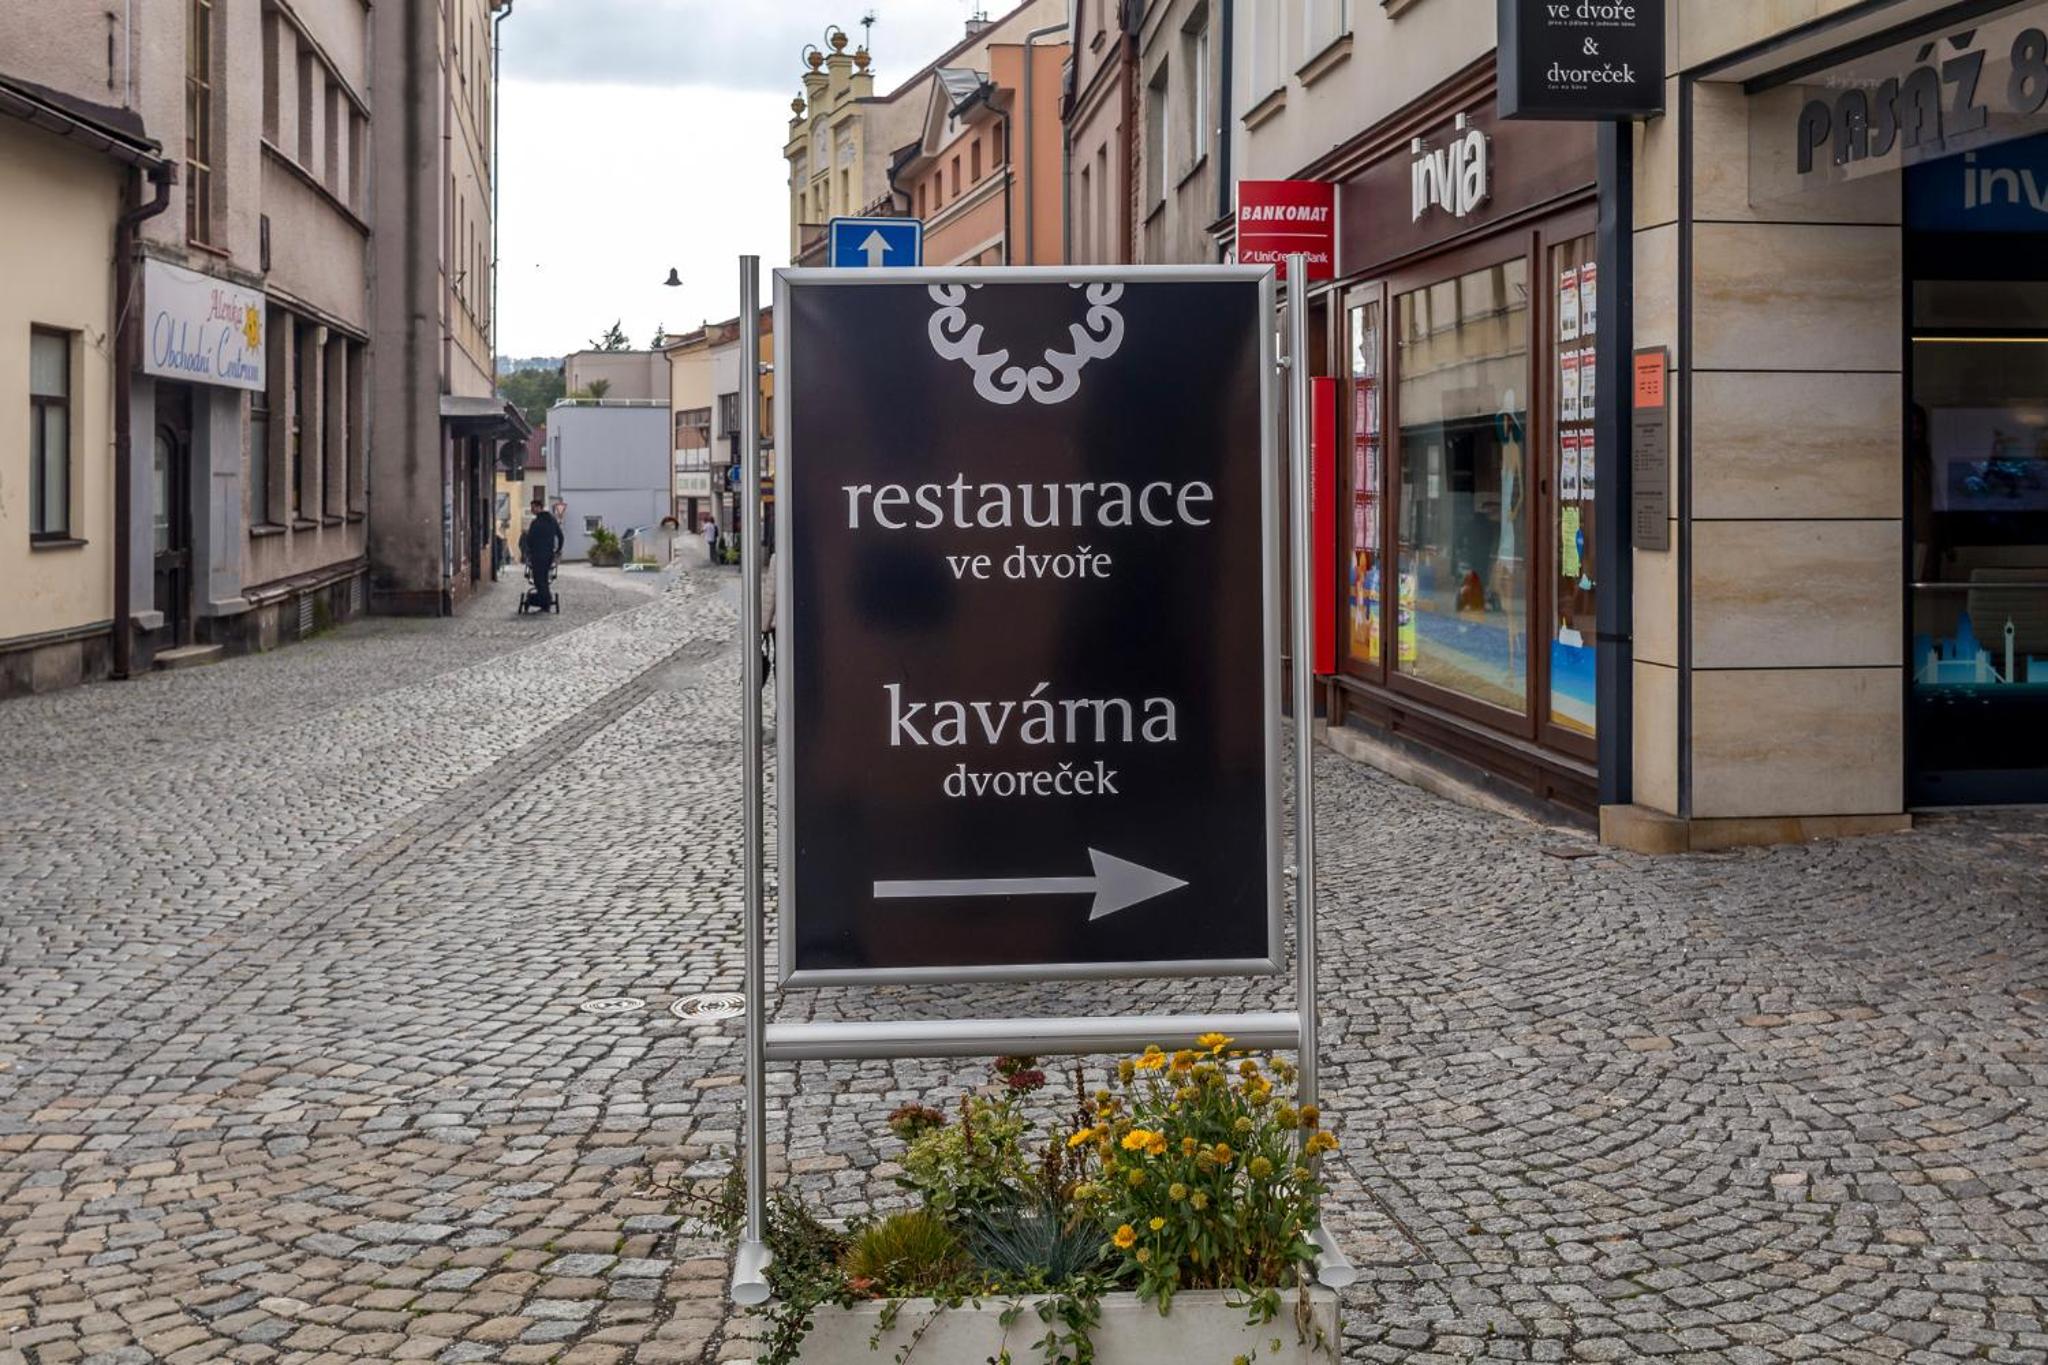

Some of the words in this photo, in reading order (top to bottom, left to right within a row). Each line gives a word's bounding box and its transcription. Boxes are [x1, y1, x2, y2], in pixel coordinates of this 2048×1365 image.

[1546, 4, 1571, 19] ve
[1576, 0, 1636, 20] dvoře
[1583, 36, 1600, 56] &
[1546, 61, 1637, 84] dvoreček
[1797, 29, 1988, 175] PASÁŽ
[2007, 27, 2048, 114] 8
[1411, 112, 1487, 224] invia
[1241, 205, 1329, 222] BANKOMAT
[153, 310, 211, 374] Obchodní
[217, 325, 260, 381] Centrum
[841, 472, 1214, 530] restaurace
[945, 554, 992, 580] ve
[1003, 545, 1113, 580] dvoře
[882, 682, 1178, 747] kavárna
[942, 760, 1120, 798] dvoreček
